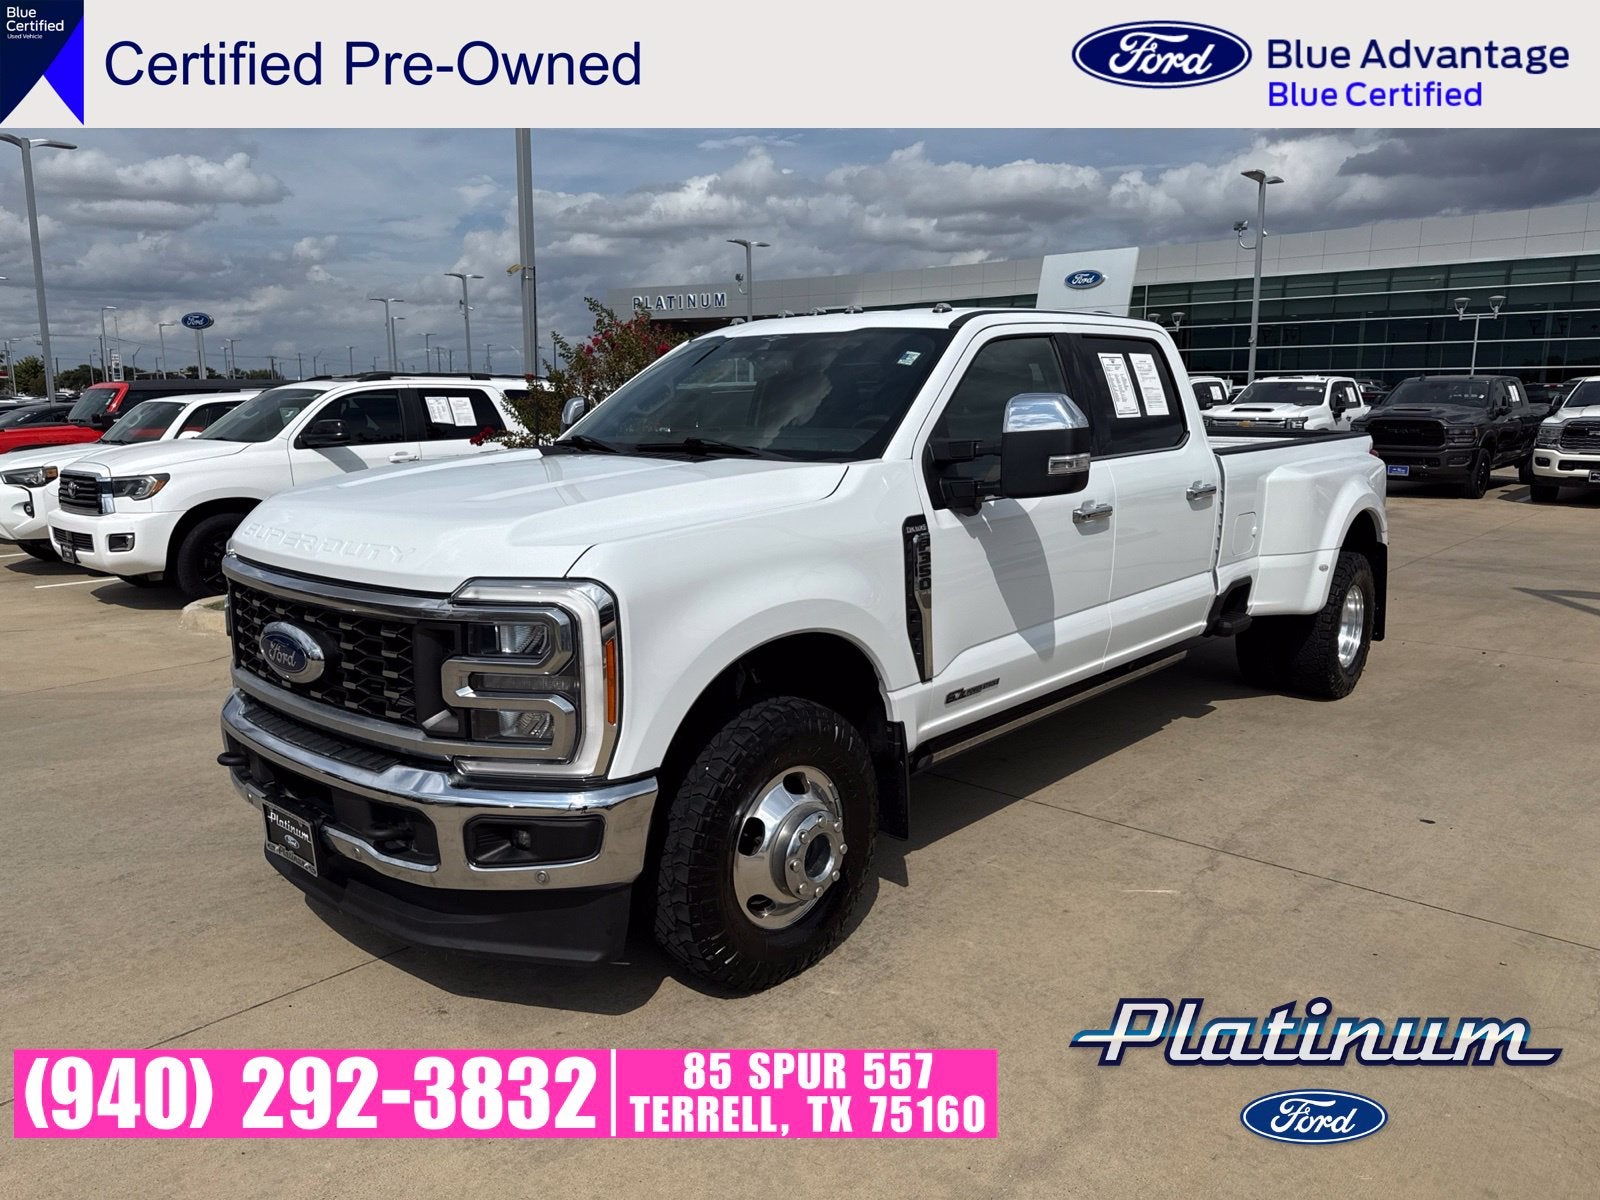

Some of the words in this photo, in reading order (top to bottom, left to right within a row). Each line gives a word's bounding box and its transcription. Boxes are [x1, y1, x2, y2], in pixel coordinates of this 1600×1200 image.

[631, 292, 727, 311] PLATINUM
[242, 522, 318, 552] SUPER
[317, 537, 417, 563] DUTY
[268, 639, 297, 668] Ford
[267, 809, 313, 844] Platinum
